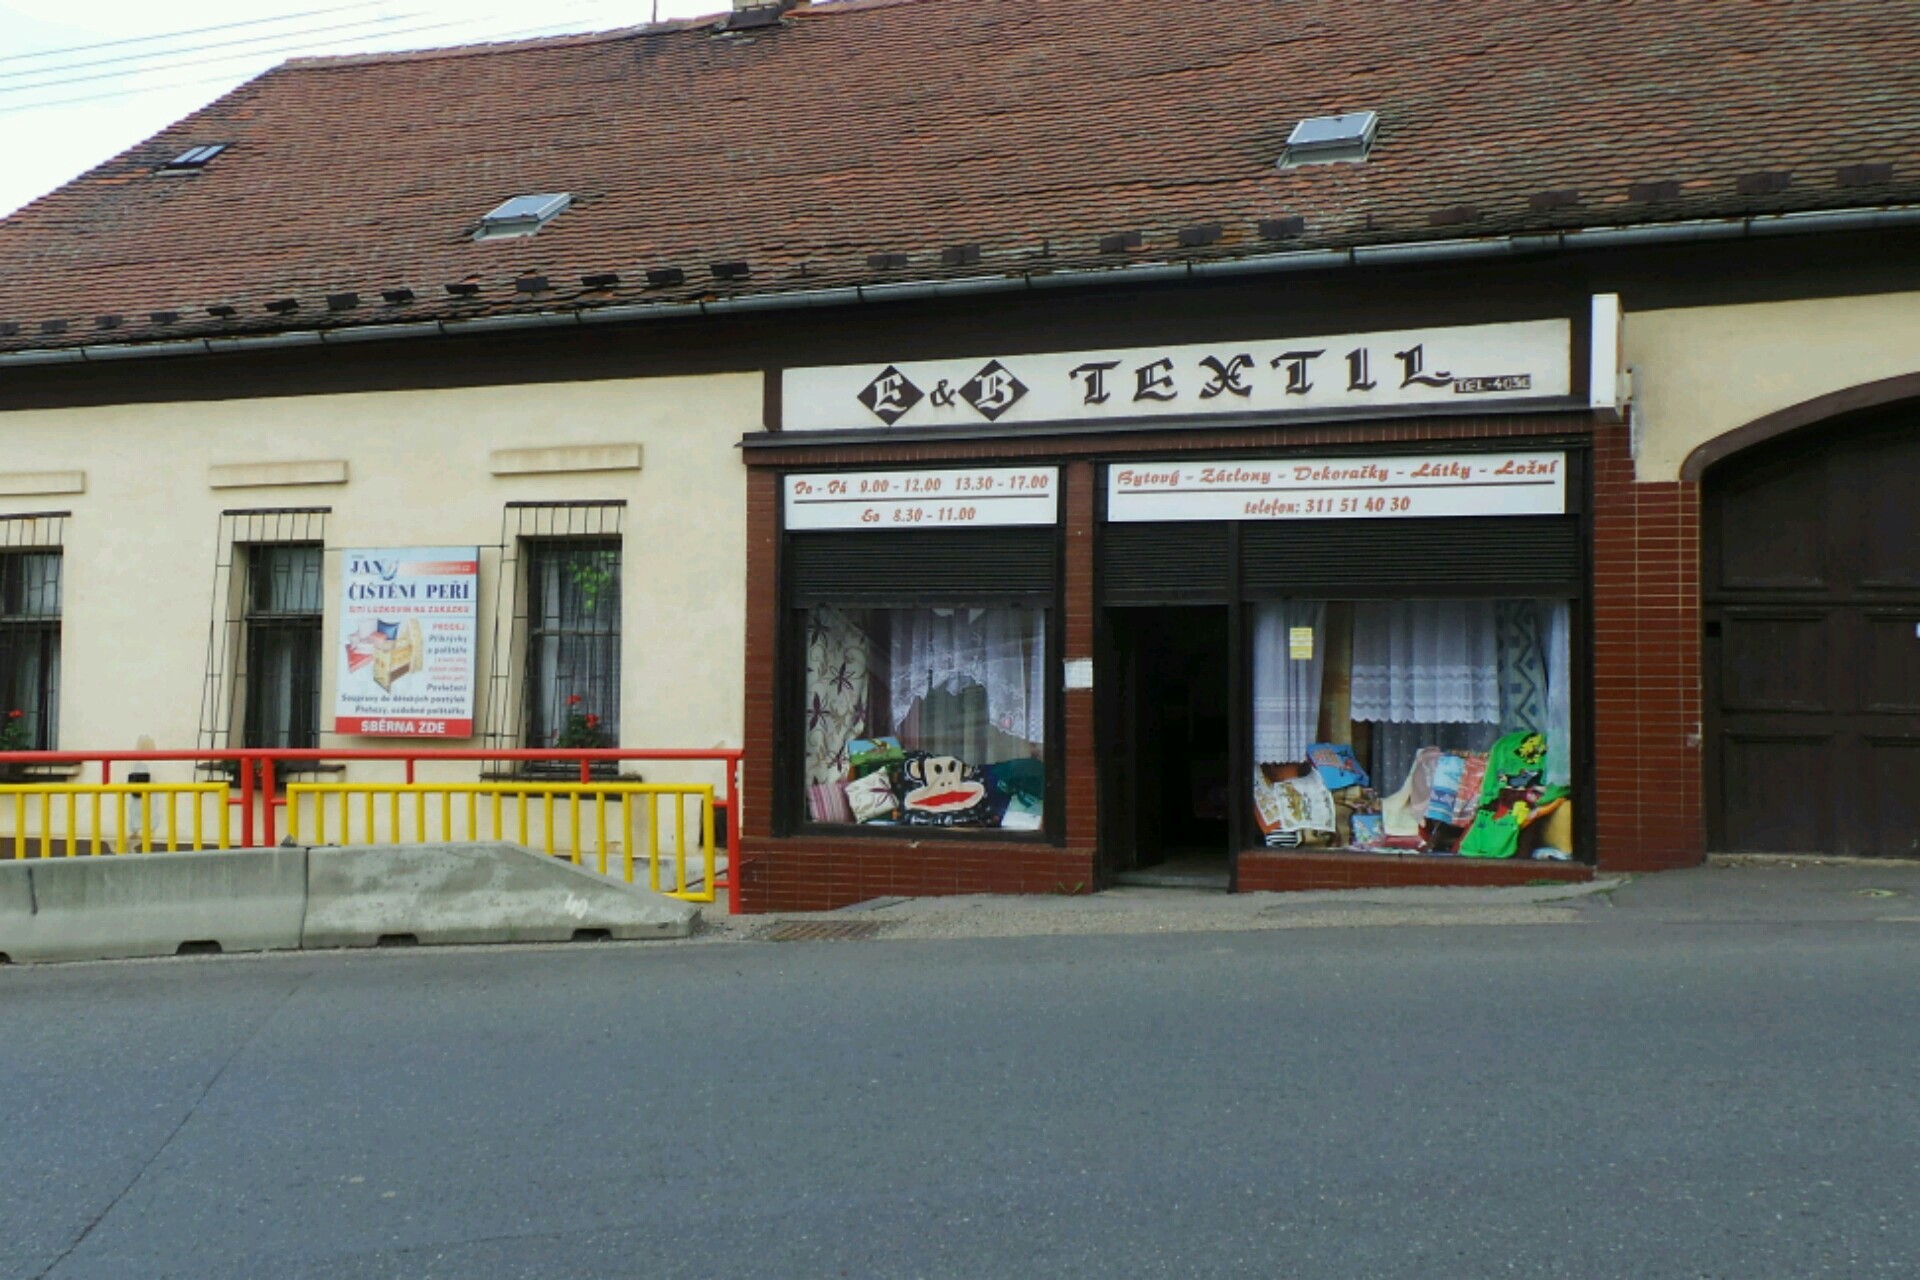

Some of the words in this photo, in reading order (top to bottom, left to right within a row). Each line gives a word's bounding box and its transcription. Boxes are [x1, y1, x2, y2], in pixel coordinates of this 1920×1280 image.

[930, 378, 958, 408] &
[973, 368, 1015, 411] B
[1068, 343, 1454, 405] TEXTIL
[1117, 469, 1181, 486] Bytový
[1199, 467, 1271, 485] Záclony
[1293, 464, 1389, 482] Dekoračky
[1410, 462, 1471, 479] Látky
[1494, 459, 1559, 476] Ložní
[793, 480, 812, 495] Po
[827, 480, 847, 494] Pá
[860, 479, 889, 493] 9.00
[904, 477, 942, 492] 12.00
[955, 476, 993, 491] 13.30
[1009, 474, 1048, 490] 17.00
[892, 507, 923, 522] 8.30
[938, 507, 976, 521] 11.00
[1244, 498, 1301, 516] telefon:
[1305, 498, 1334, 513] 311
[1340, 497, 1358, 512] 51
[1365, 497, 1385, 512] 40
[1390, 496, 1411, 511] 30
[349, 560, 383, 574] JAN
[426, 580, 469, 599] PEŘÍ
[361, 719, 414, 732] SBĚRNA
[418, 721, 445, 734] ZDE
